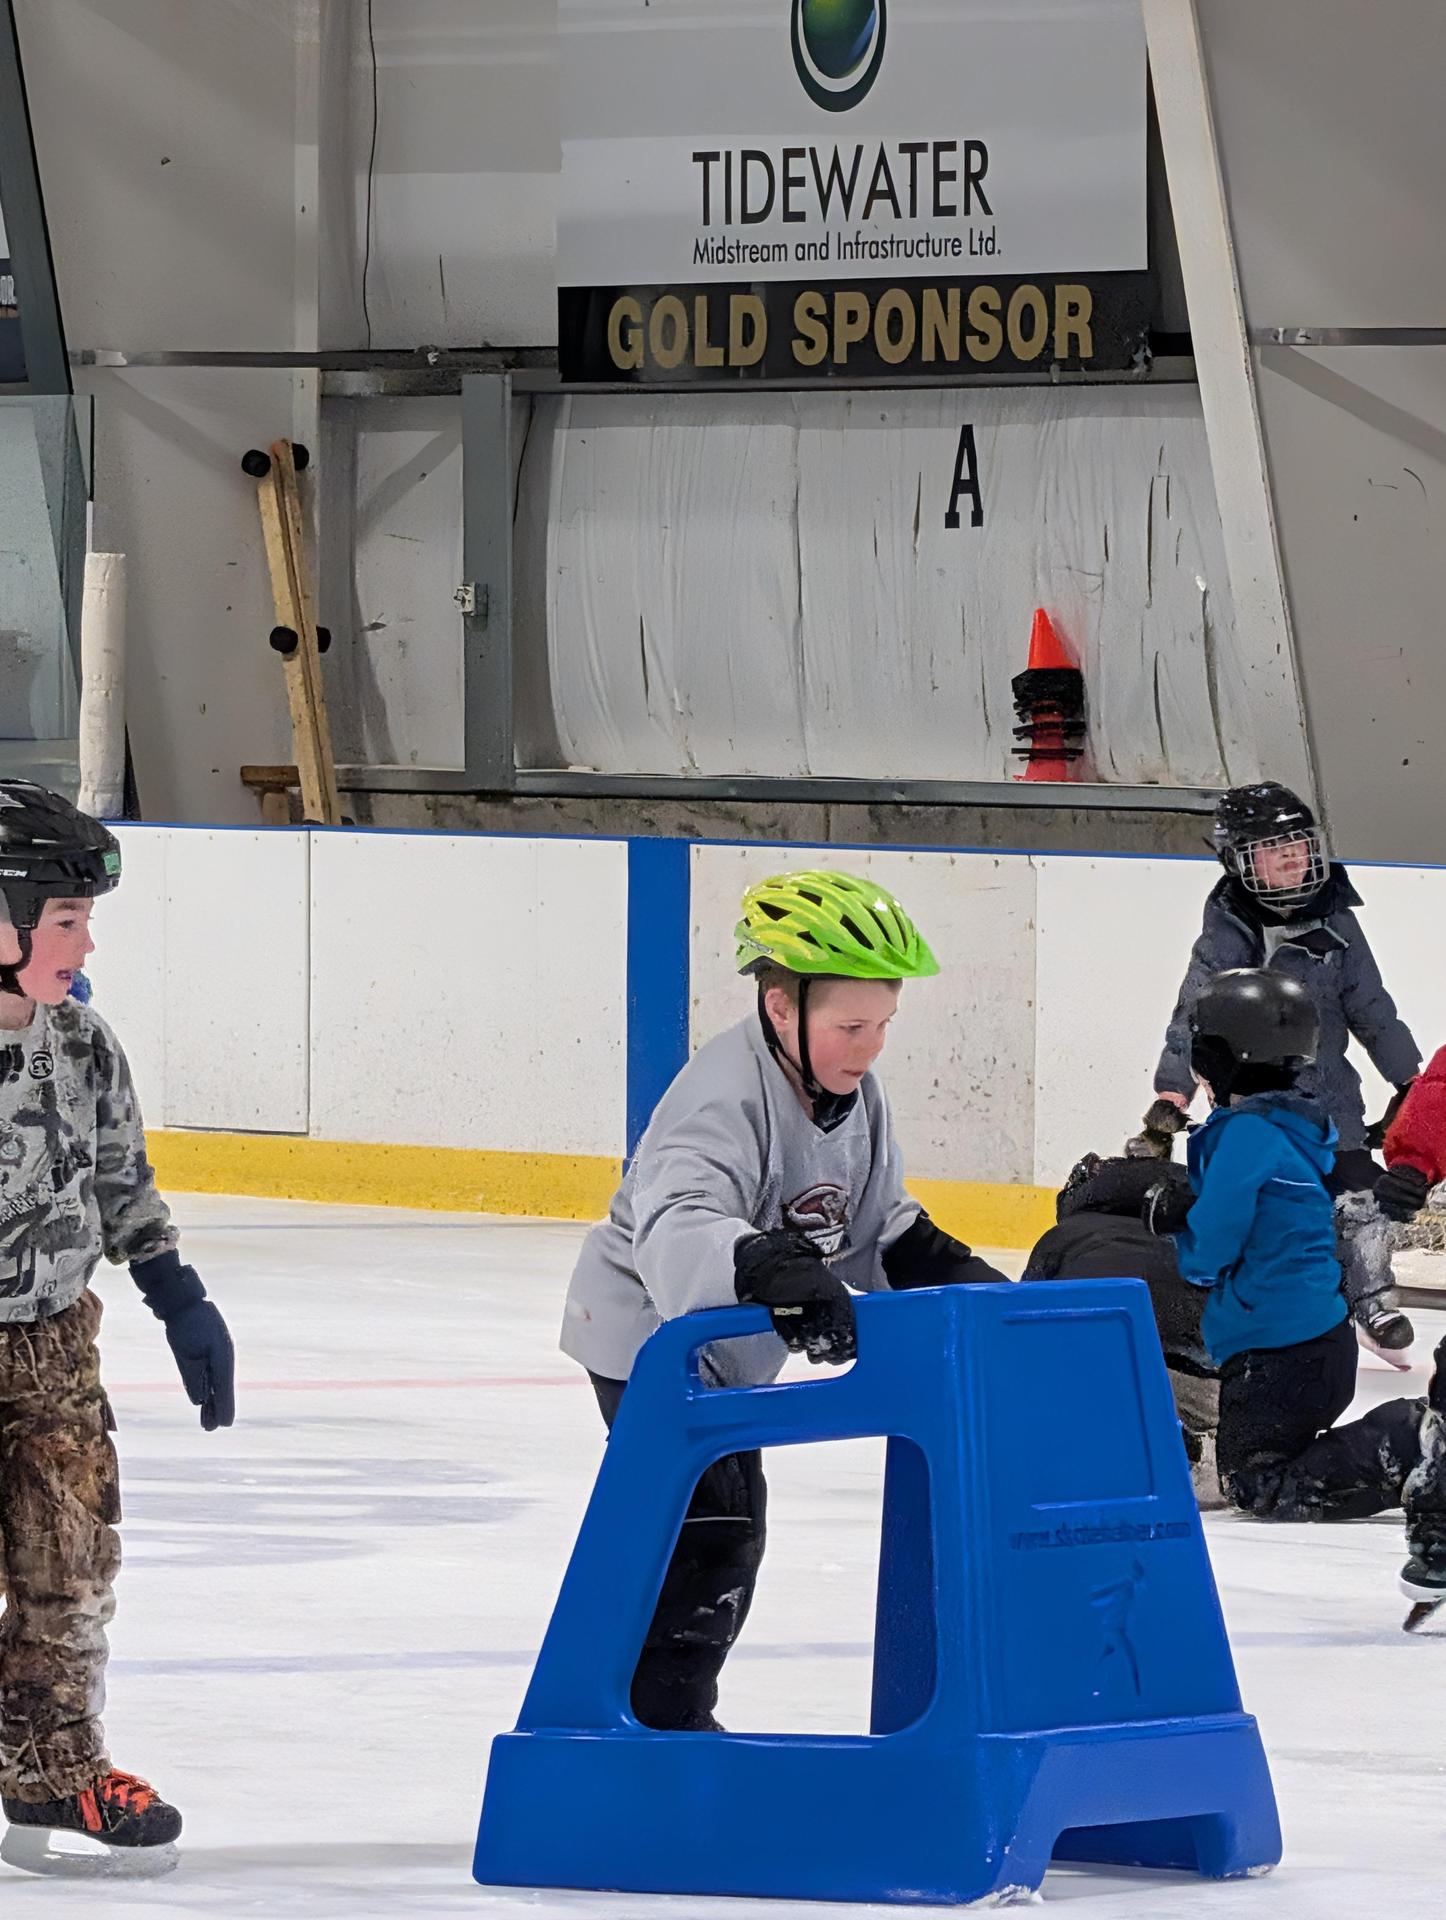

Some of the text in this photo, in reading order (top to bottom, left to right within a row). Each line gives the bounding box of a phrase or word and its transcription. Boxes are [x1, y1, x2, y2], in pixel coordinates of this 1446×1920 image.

[692, 140, 994, 226] TIDEWATER
[693, 225, 1002, 265] Midstream and Infrastructure Ltd.
[607, 284, 1093, 370] GOLD SPONSOR
[944, 423, 984, 529] A
